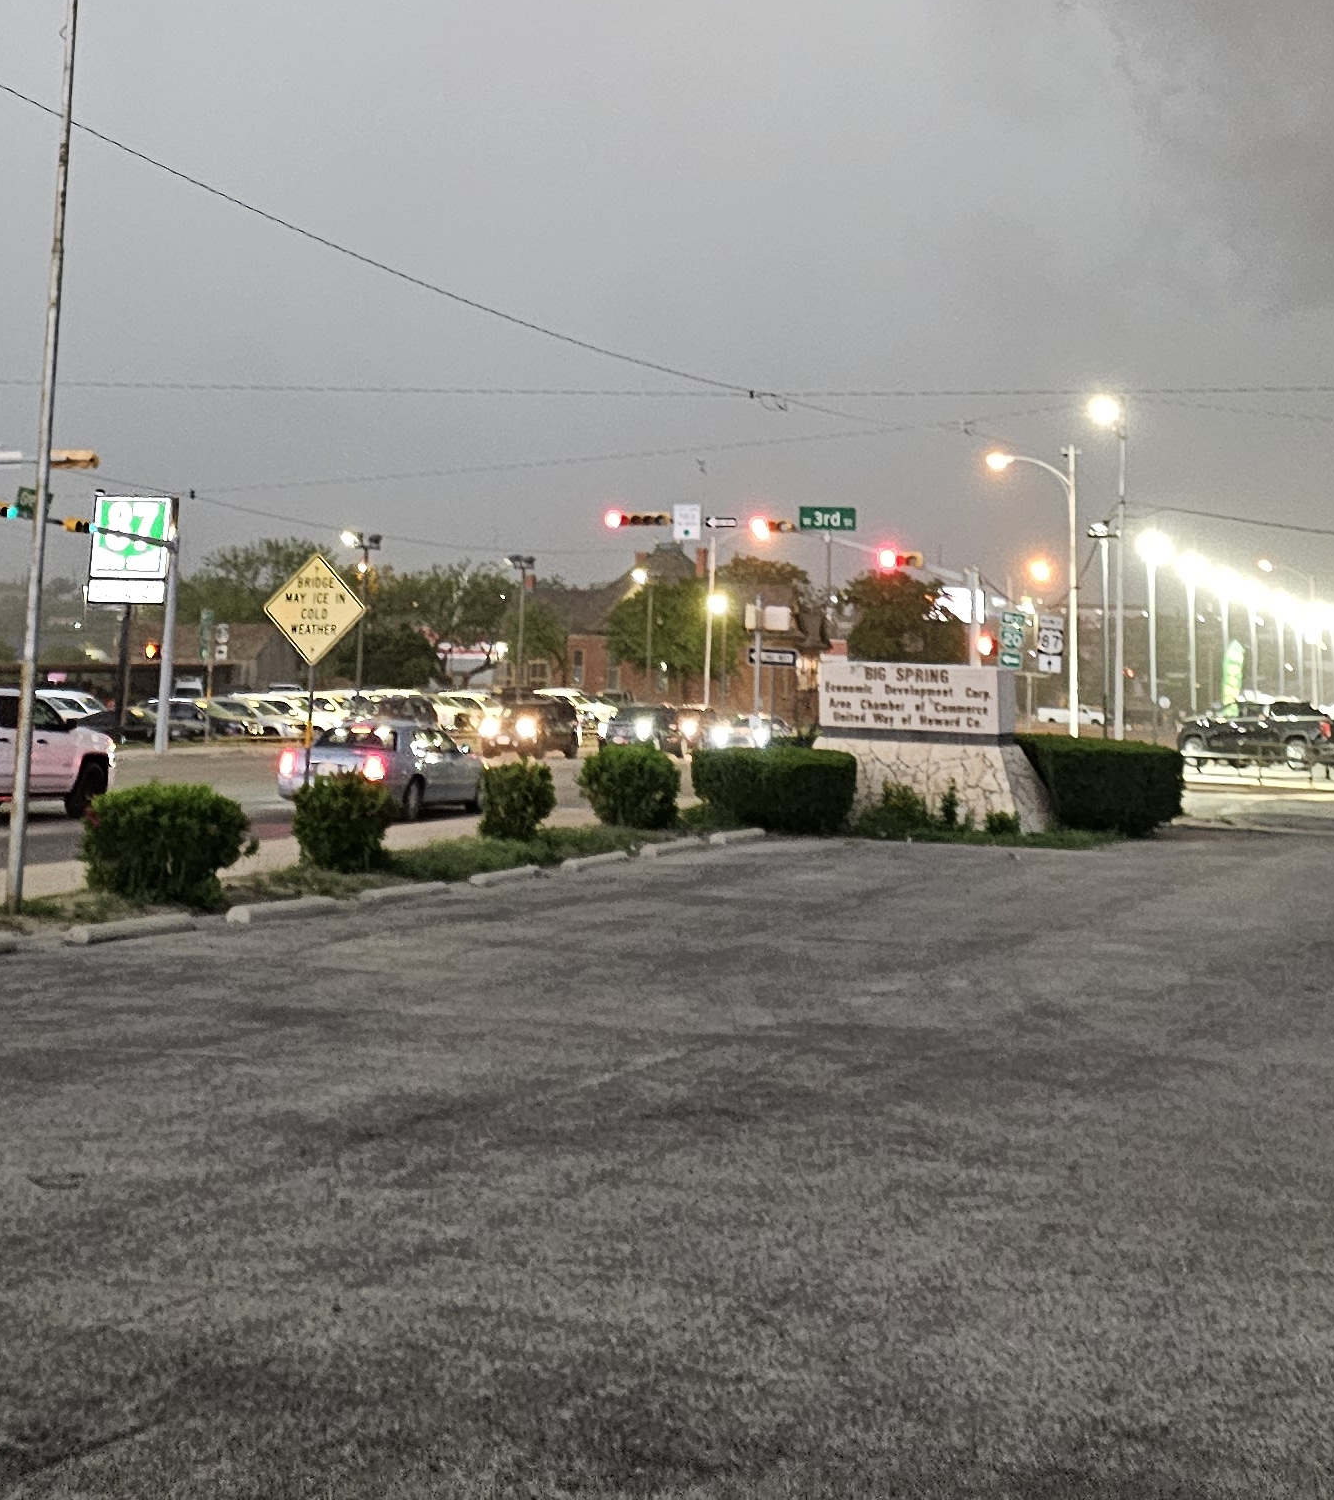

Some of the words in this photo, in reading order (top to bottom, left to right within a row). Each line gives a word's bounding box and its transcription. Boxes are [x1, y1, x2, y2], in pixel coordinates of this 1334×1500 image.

[104, 500, 161, 552] 87
[813, 510, 841, 527] 3rd
[297, 577, 335, 589] BRIDGE
[285, 593, 306, 604] MAY
[313, 592, 329, 604] ICE
[335, 592, 346, 604] IN
[301, 608, 328, 620] COLD
[291, 623, 337, 636] WEATHER
[1041, 634, 1060, 650] 87
[865, 666, 886, 682] BIG
[896, 667, 949, 684] SPRING
[825, 681, 873, 695] Economic
[884, 684, 954, 699] Development
[829, 698, 852, 709] Area
[860, 699, 905, 712] Chamber
[915, 701, 925, 713] of
[934, 702, 989, 717] Commerce
[833, 711, 866, 723] United
[873, 713, 895, 727] Way
[901, 714, 912, 726] of
